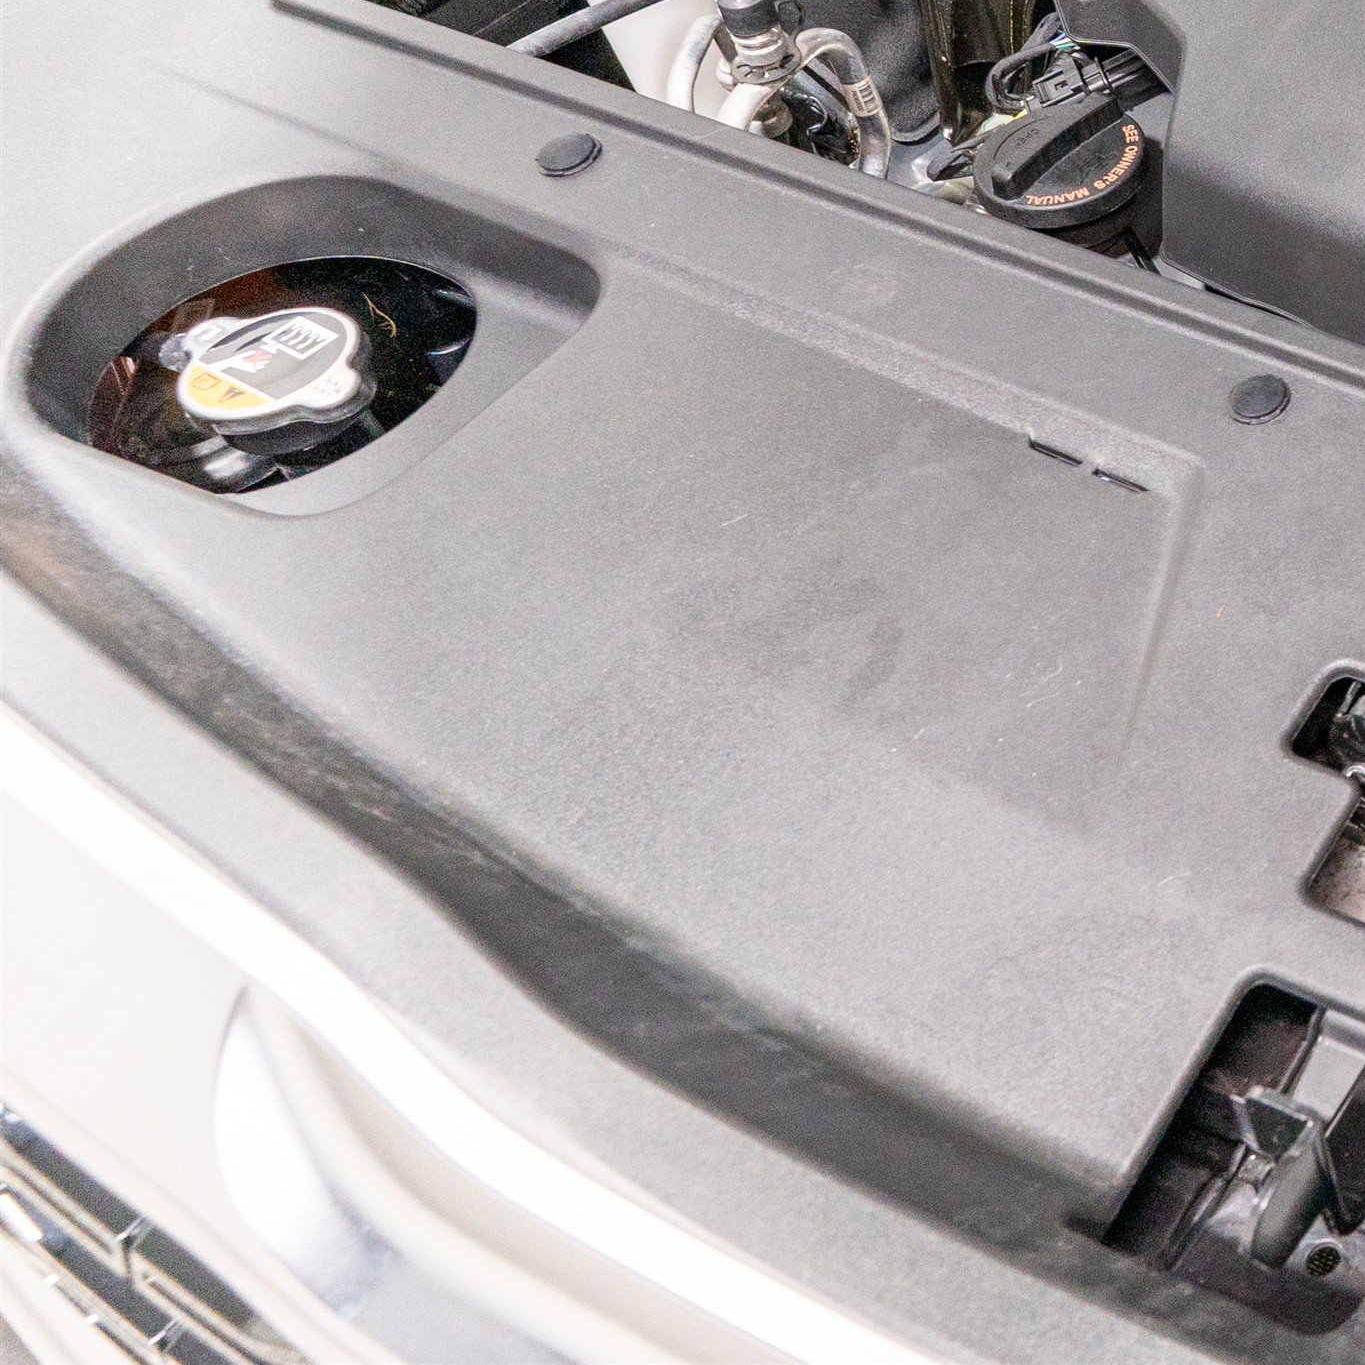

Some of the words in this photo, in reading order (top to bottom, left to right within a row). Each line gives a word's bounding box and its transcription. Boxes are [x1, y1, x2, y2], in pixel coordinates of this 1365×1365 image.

[1122, 124, 1140, 143] SEE
[1093, 145, 1140, 191] OWNER'S
[1026, 186, 1090, 205] MANUAL
